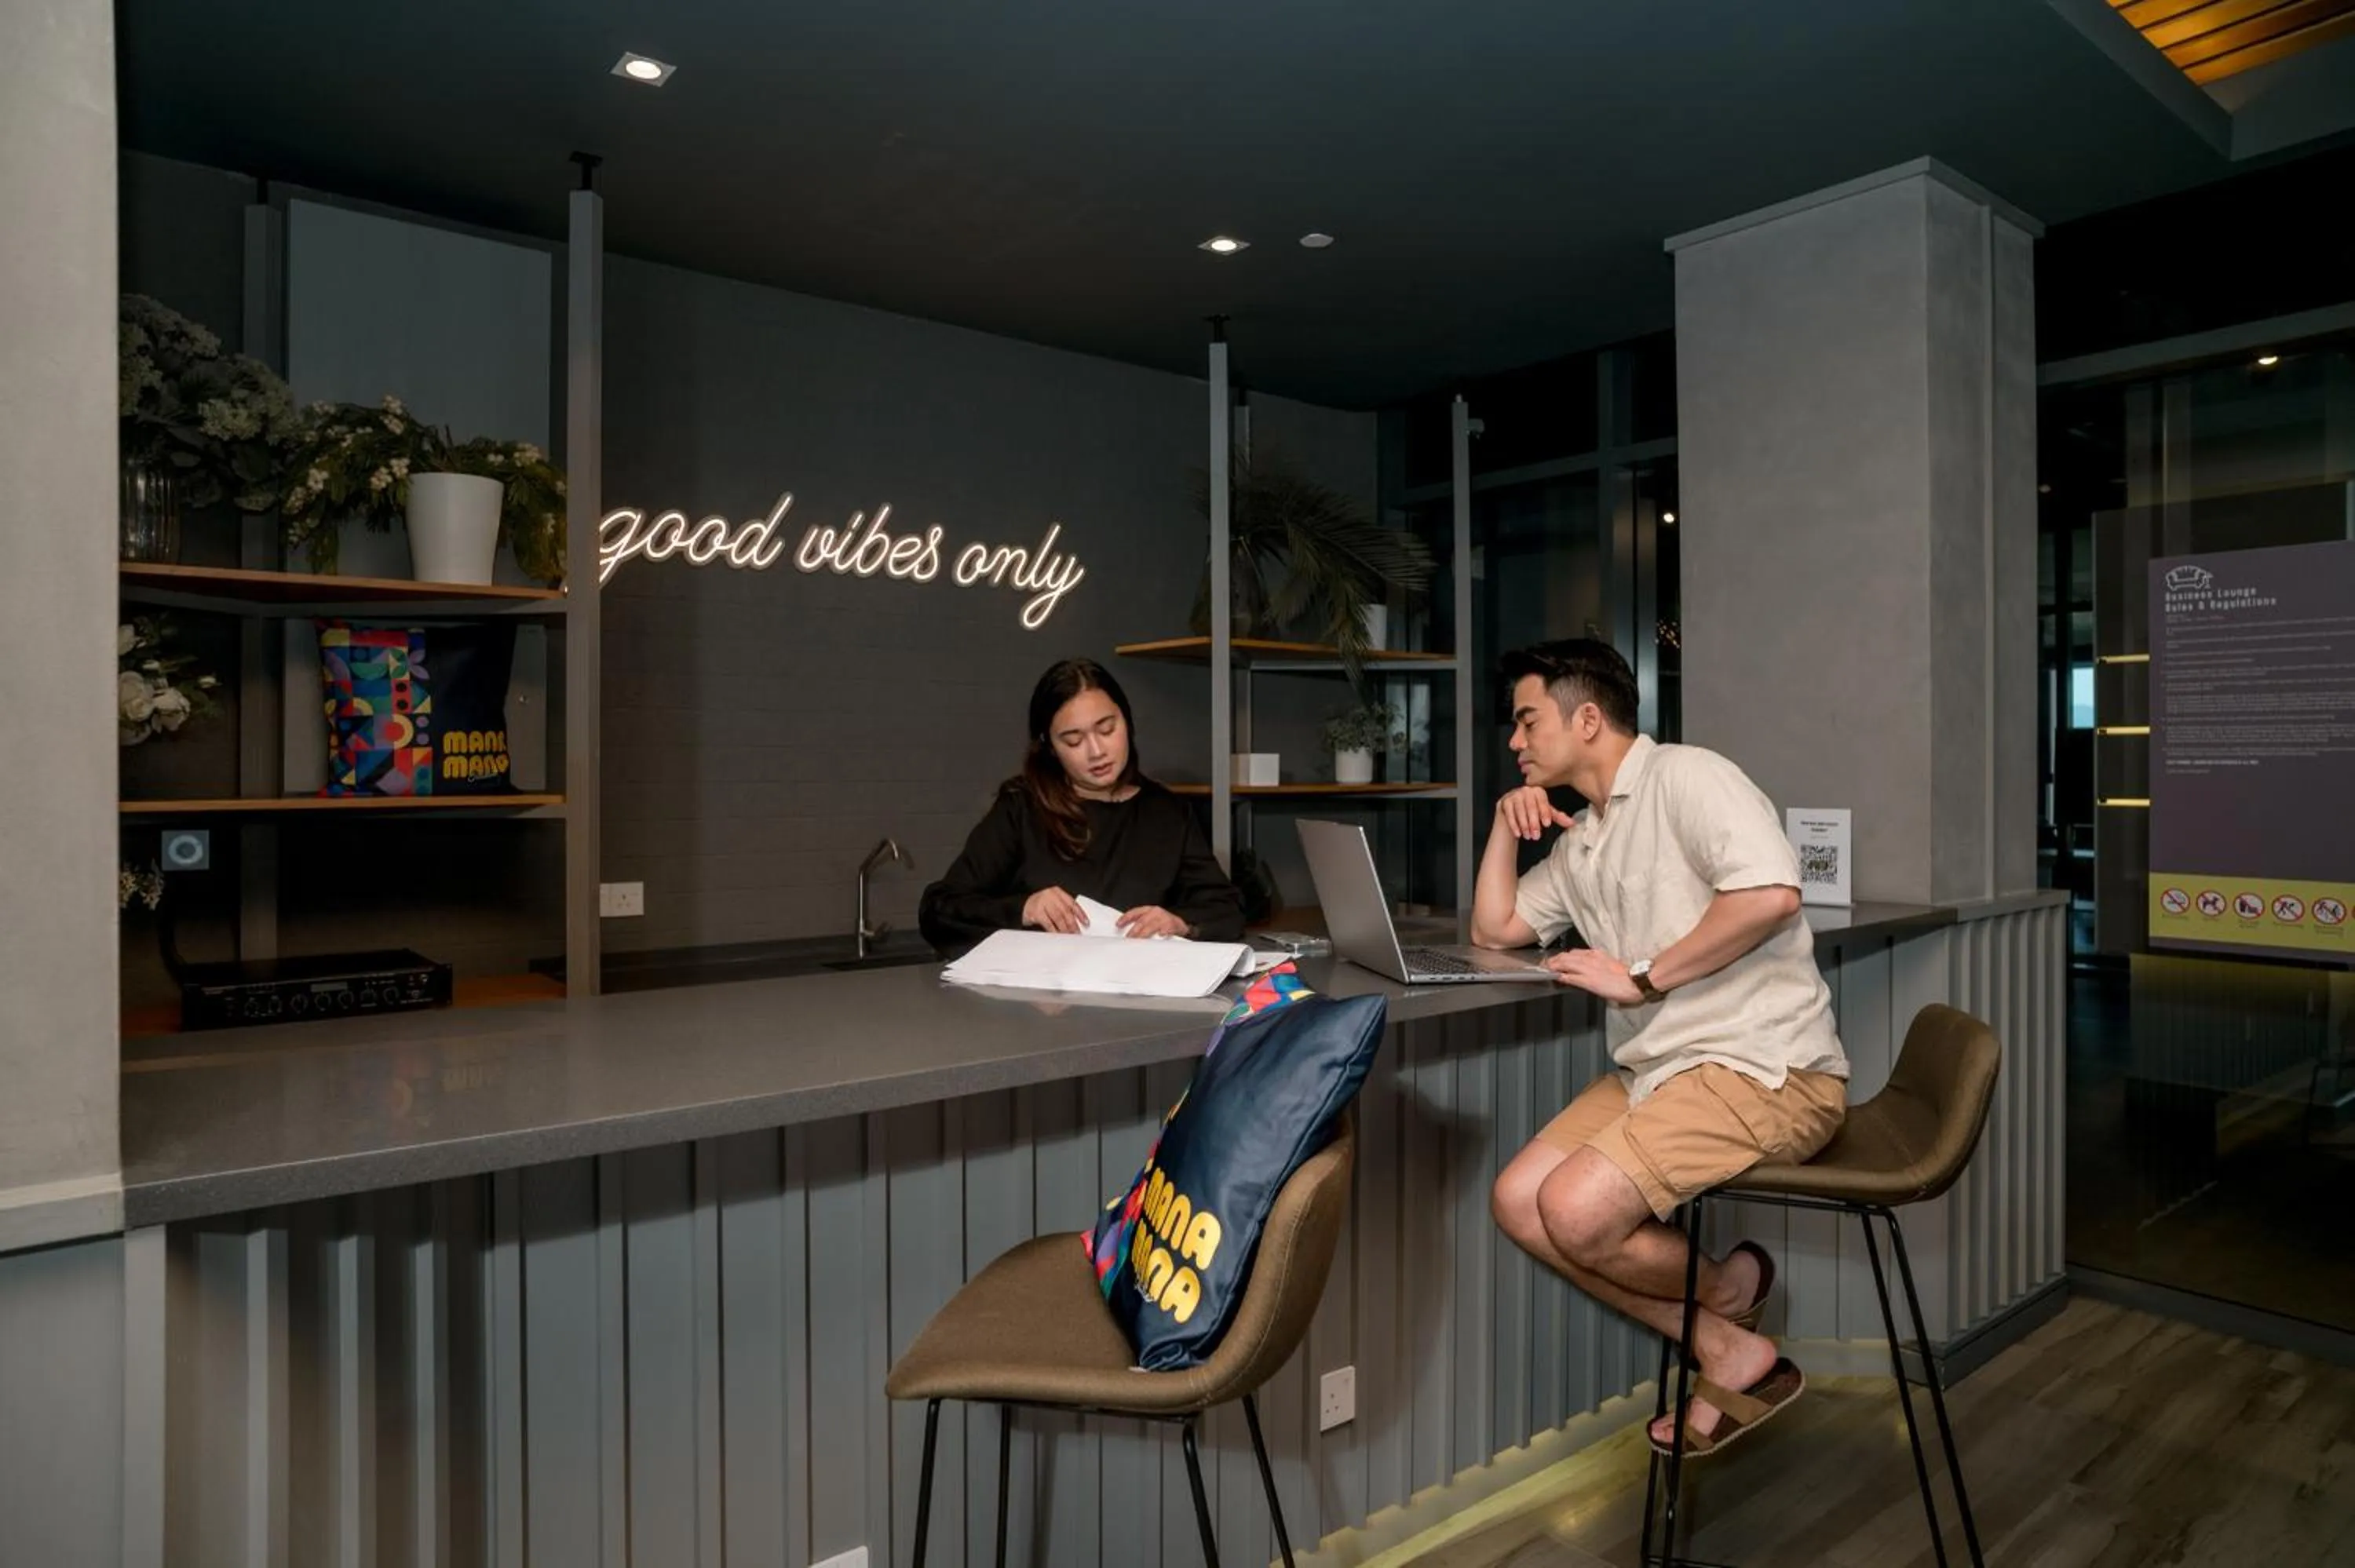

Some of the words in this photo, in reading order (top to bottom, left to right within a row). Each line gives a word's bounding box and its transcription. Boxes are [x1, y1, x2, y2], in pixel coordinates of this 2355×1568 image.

[600, 492, 793, 586] good
[798, 505, 943, 581] vibes
[955, 524, 1085, 628] only
[2218, 588, 2256, 599] Lounge
